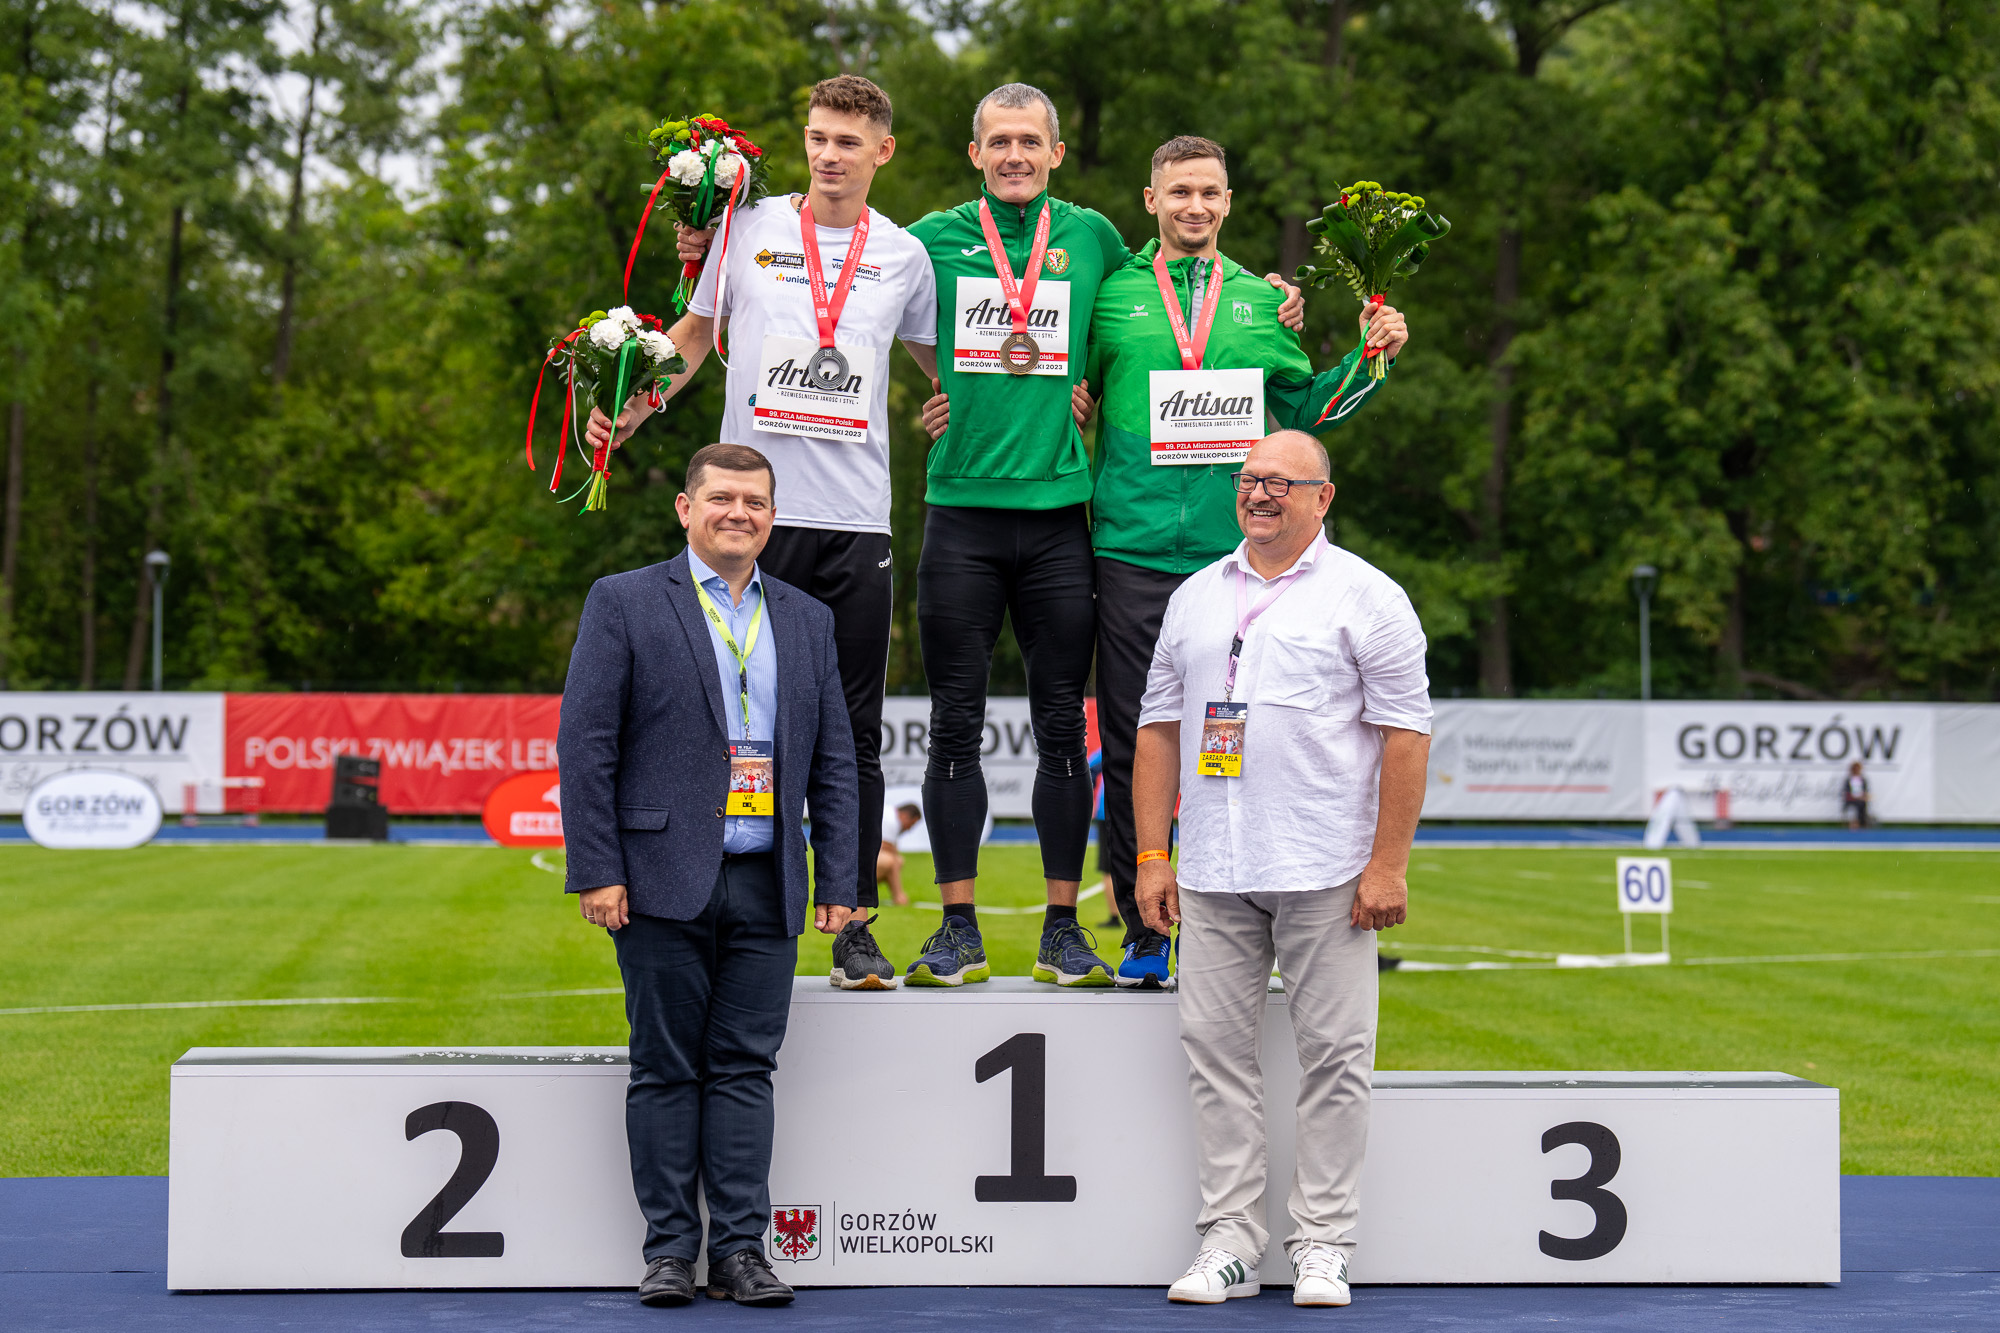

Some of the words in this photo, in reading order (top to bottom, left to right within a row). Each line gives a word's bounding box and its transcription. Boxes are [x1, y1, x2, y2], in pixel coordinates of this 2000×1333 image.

[776, 256, 802, 265] OPTIMA
[966, 298, 1059, 328] Artan
[796, 414, 834, 424] Mistrzostwa
[1160, 390, 1253, 421] Artisan
[758, 420, 790, 429] GORZÓW
[792, 424, 844, 435] WIELKOPOLSKI
[0, 704, 189, 752] ORZÓW
[1678, 714, 1901, 760] GORZÓW
[244, 736, 360, 770] POLSKI
[366, 738, 506, 776] ZWIĄZEK
[37, 791, 144, 816] GORZÓW
[1625, 866, 1664, 902] 60
[974, 1032, 1077, 1203] 1
[400, 1100, 504, 1258] 2
[1538, 1122, 1628, 1260] 3
[840, 1208, 936, 1231] GORZÓW
[840, 1236, 993, 1253] WIELKOPOLSKI
